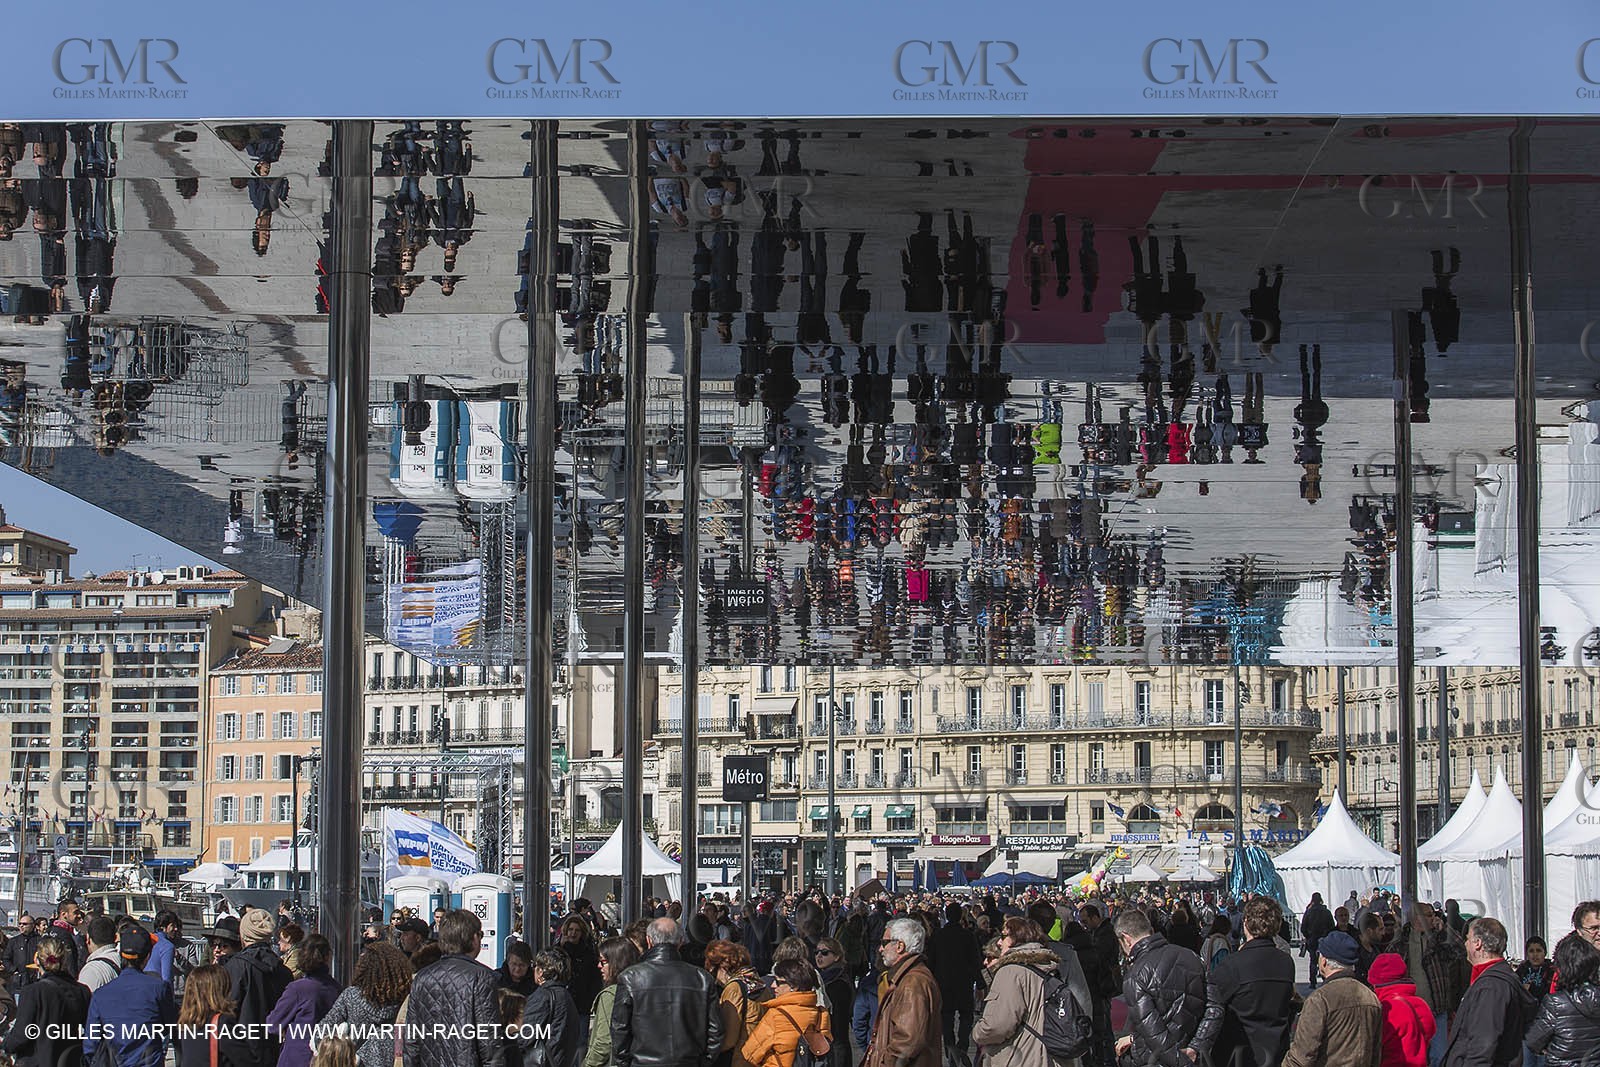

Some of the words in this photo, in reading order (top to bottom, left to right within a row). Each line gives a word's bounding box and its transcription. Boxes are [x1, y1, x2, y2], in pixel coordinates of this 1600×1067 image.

[726, 767, 764, 785] Métro
[1005, 836, 1069, 845] RESTAURANT
[1111, 833, 1160, 842] BRASSERIE
[398, 837, 429, 853] MPM
